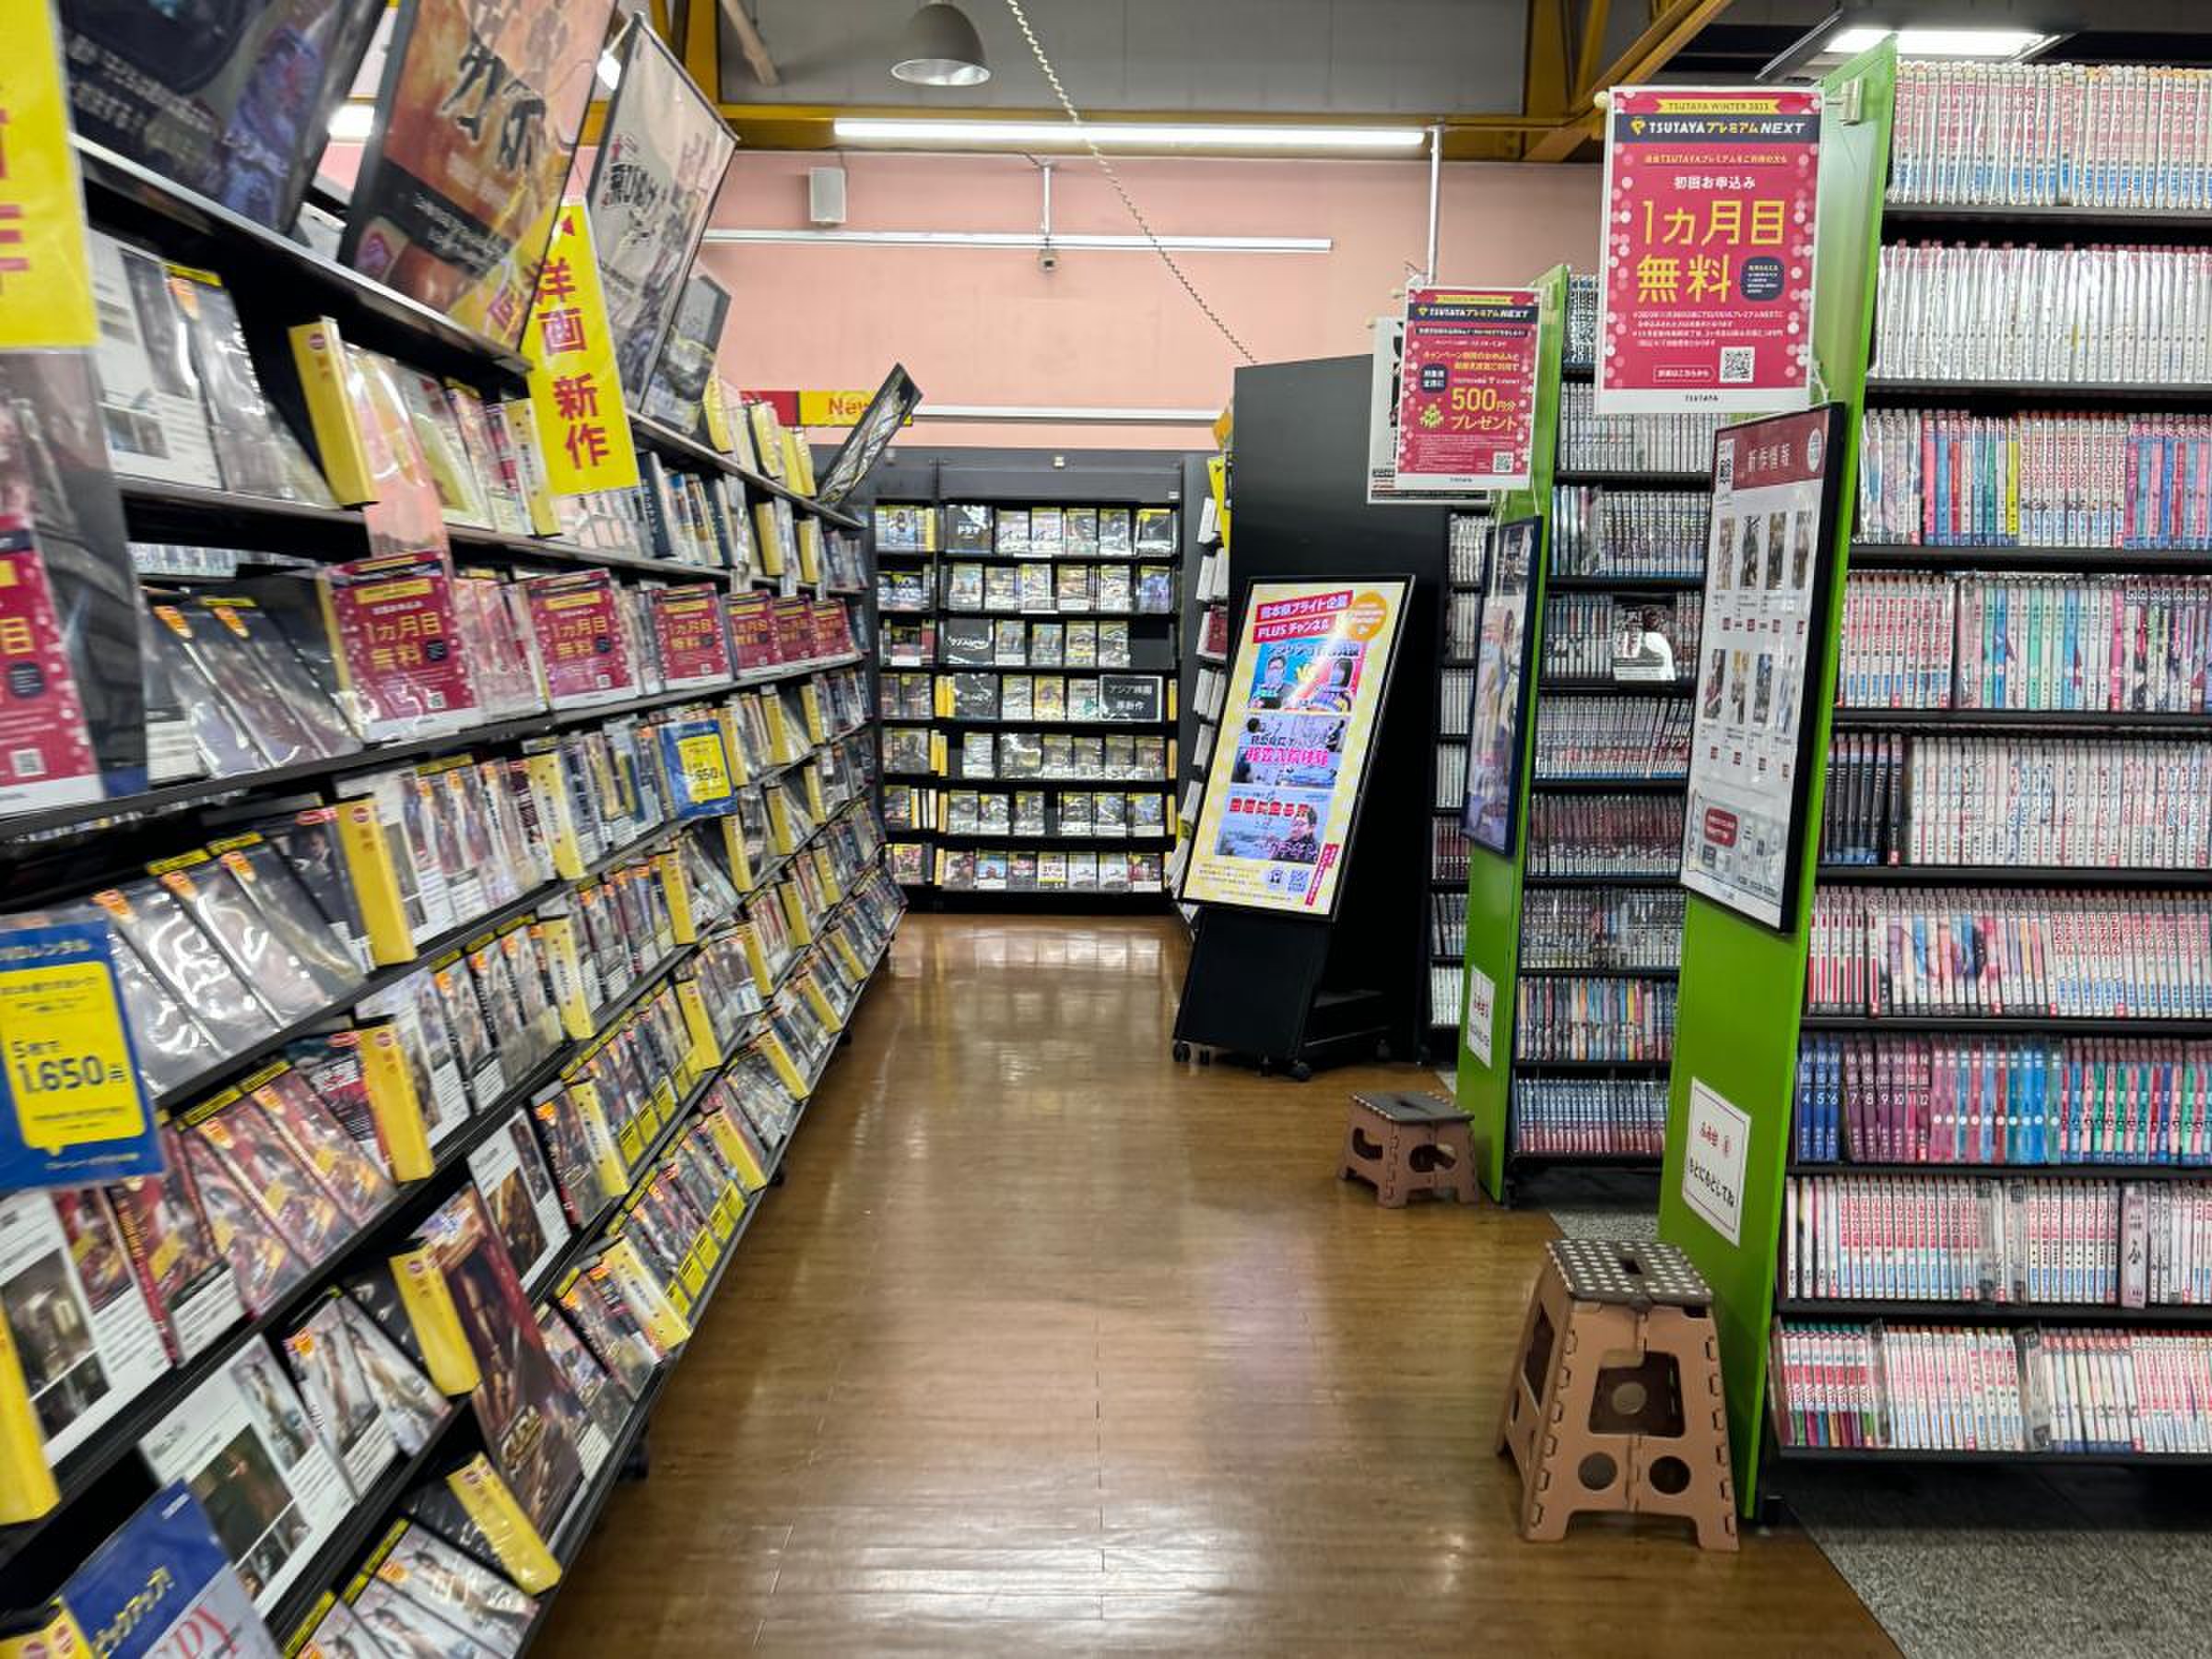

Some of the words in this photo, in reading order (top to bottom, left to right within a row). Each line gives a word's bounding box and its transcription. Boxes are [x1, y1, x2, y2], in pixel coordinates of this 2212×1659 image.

[1711, 102, 1747, 112] WINTER
[1649, 122, 1806, 135] TSUTAYAプレミアムNEXT
[1674, 176, 1756, 190] 初回お申込み
[1636, 253, 1732, 303] 無料
[553, 372, 610, 470] 新作
[1451, 415, 1518, 430] プレゼント
